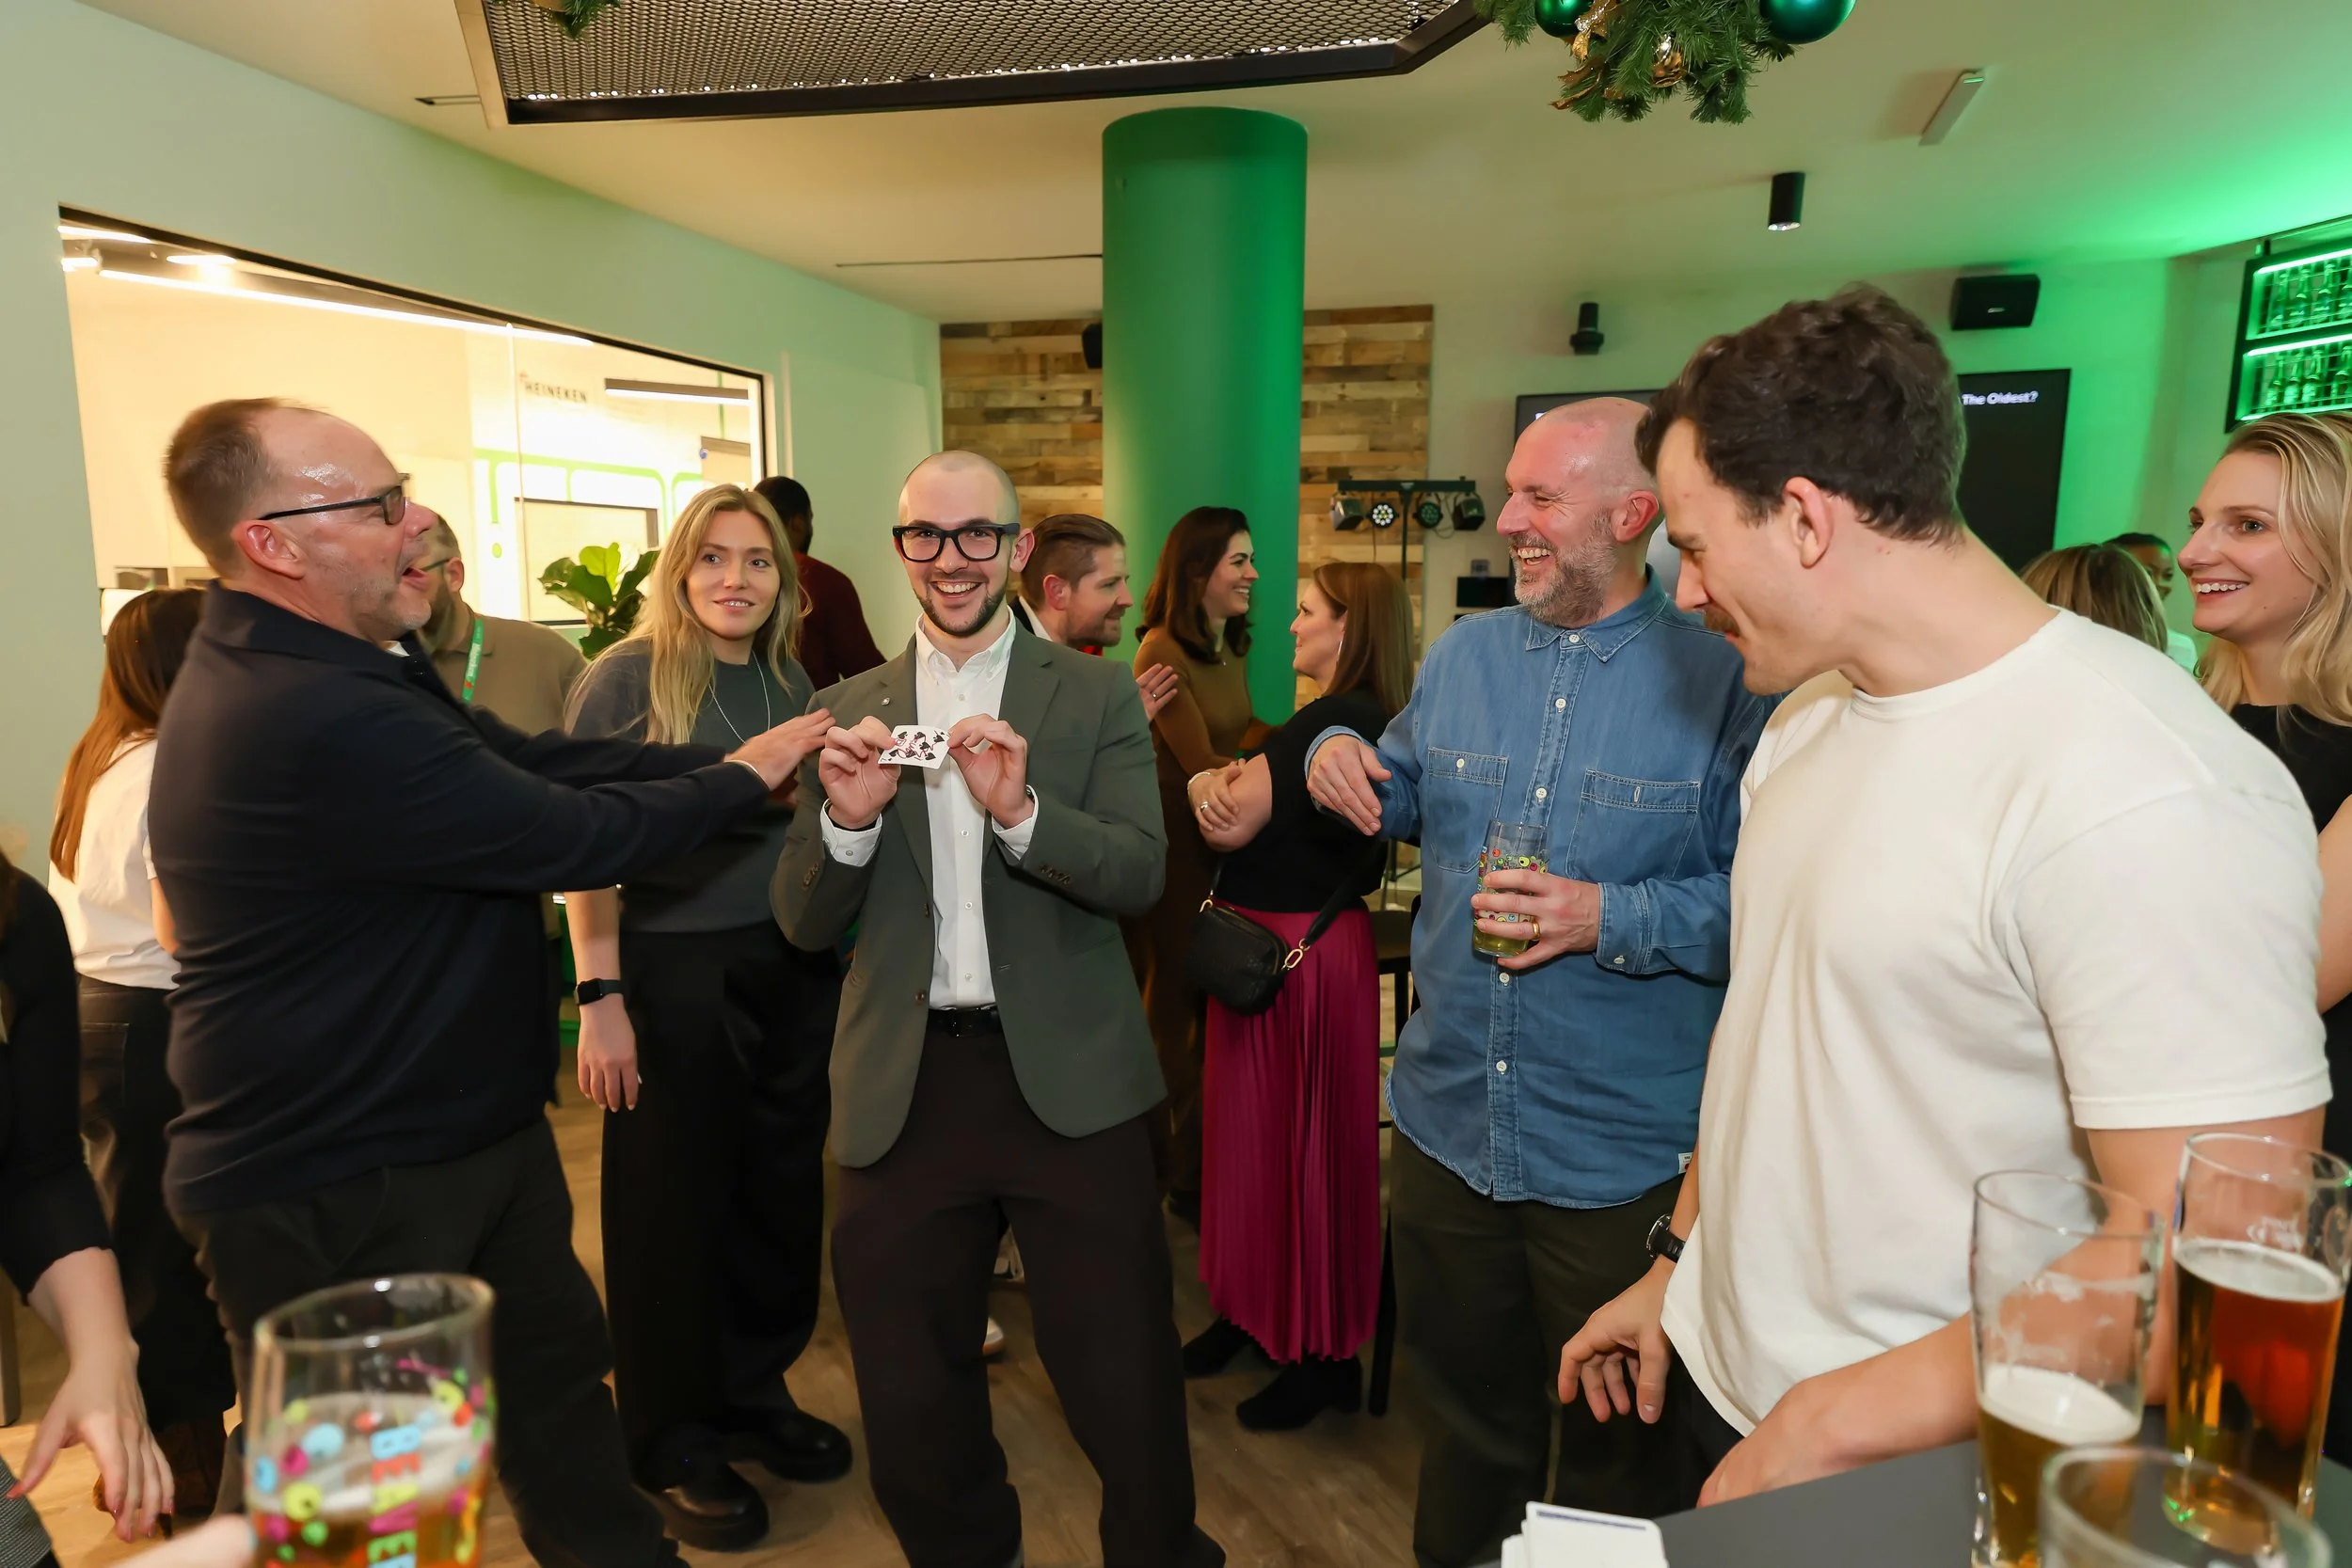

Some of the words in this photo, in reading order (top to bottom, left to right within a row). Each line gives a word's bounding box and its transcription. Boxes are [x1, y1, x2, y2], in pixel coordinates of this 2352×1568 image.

[526, 381, 587, 403] HEINEKEN
[1962, 393, 1986, 404] The
[1987, 391, 2039, 404] Oldest?
